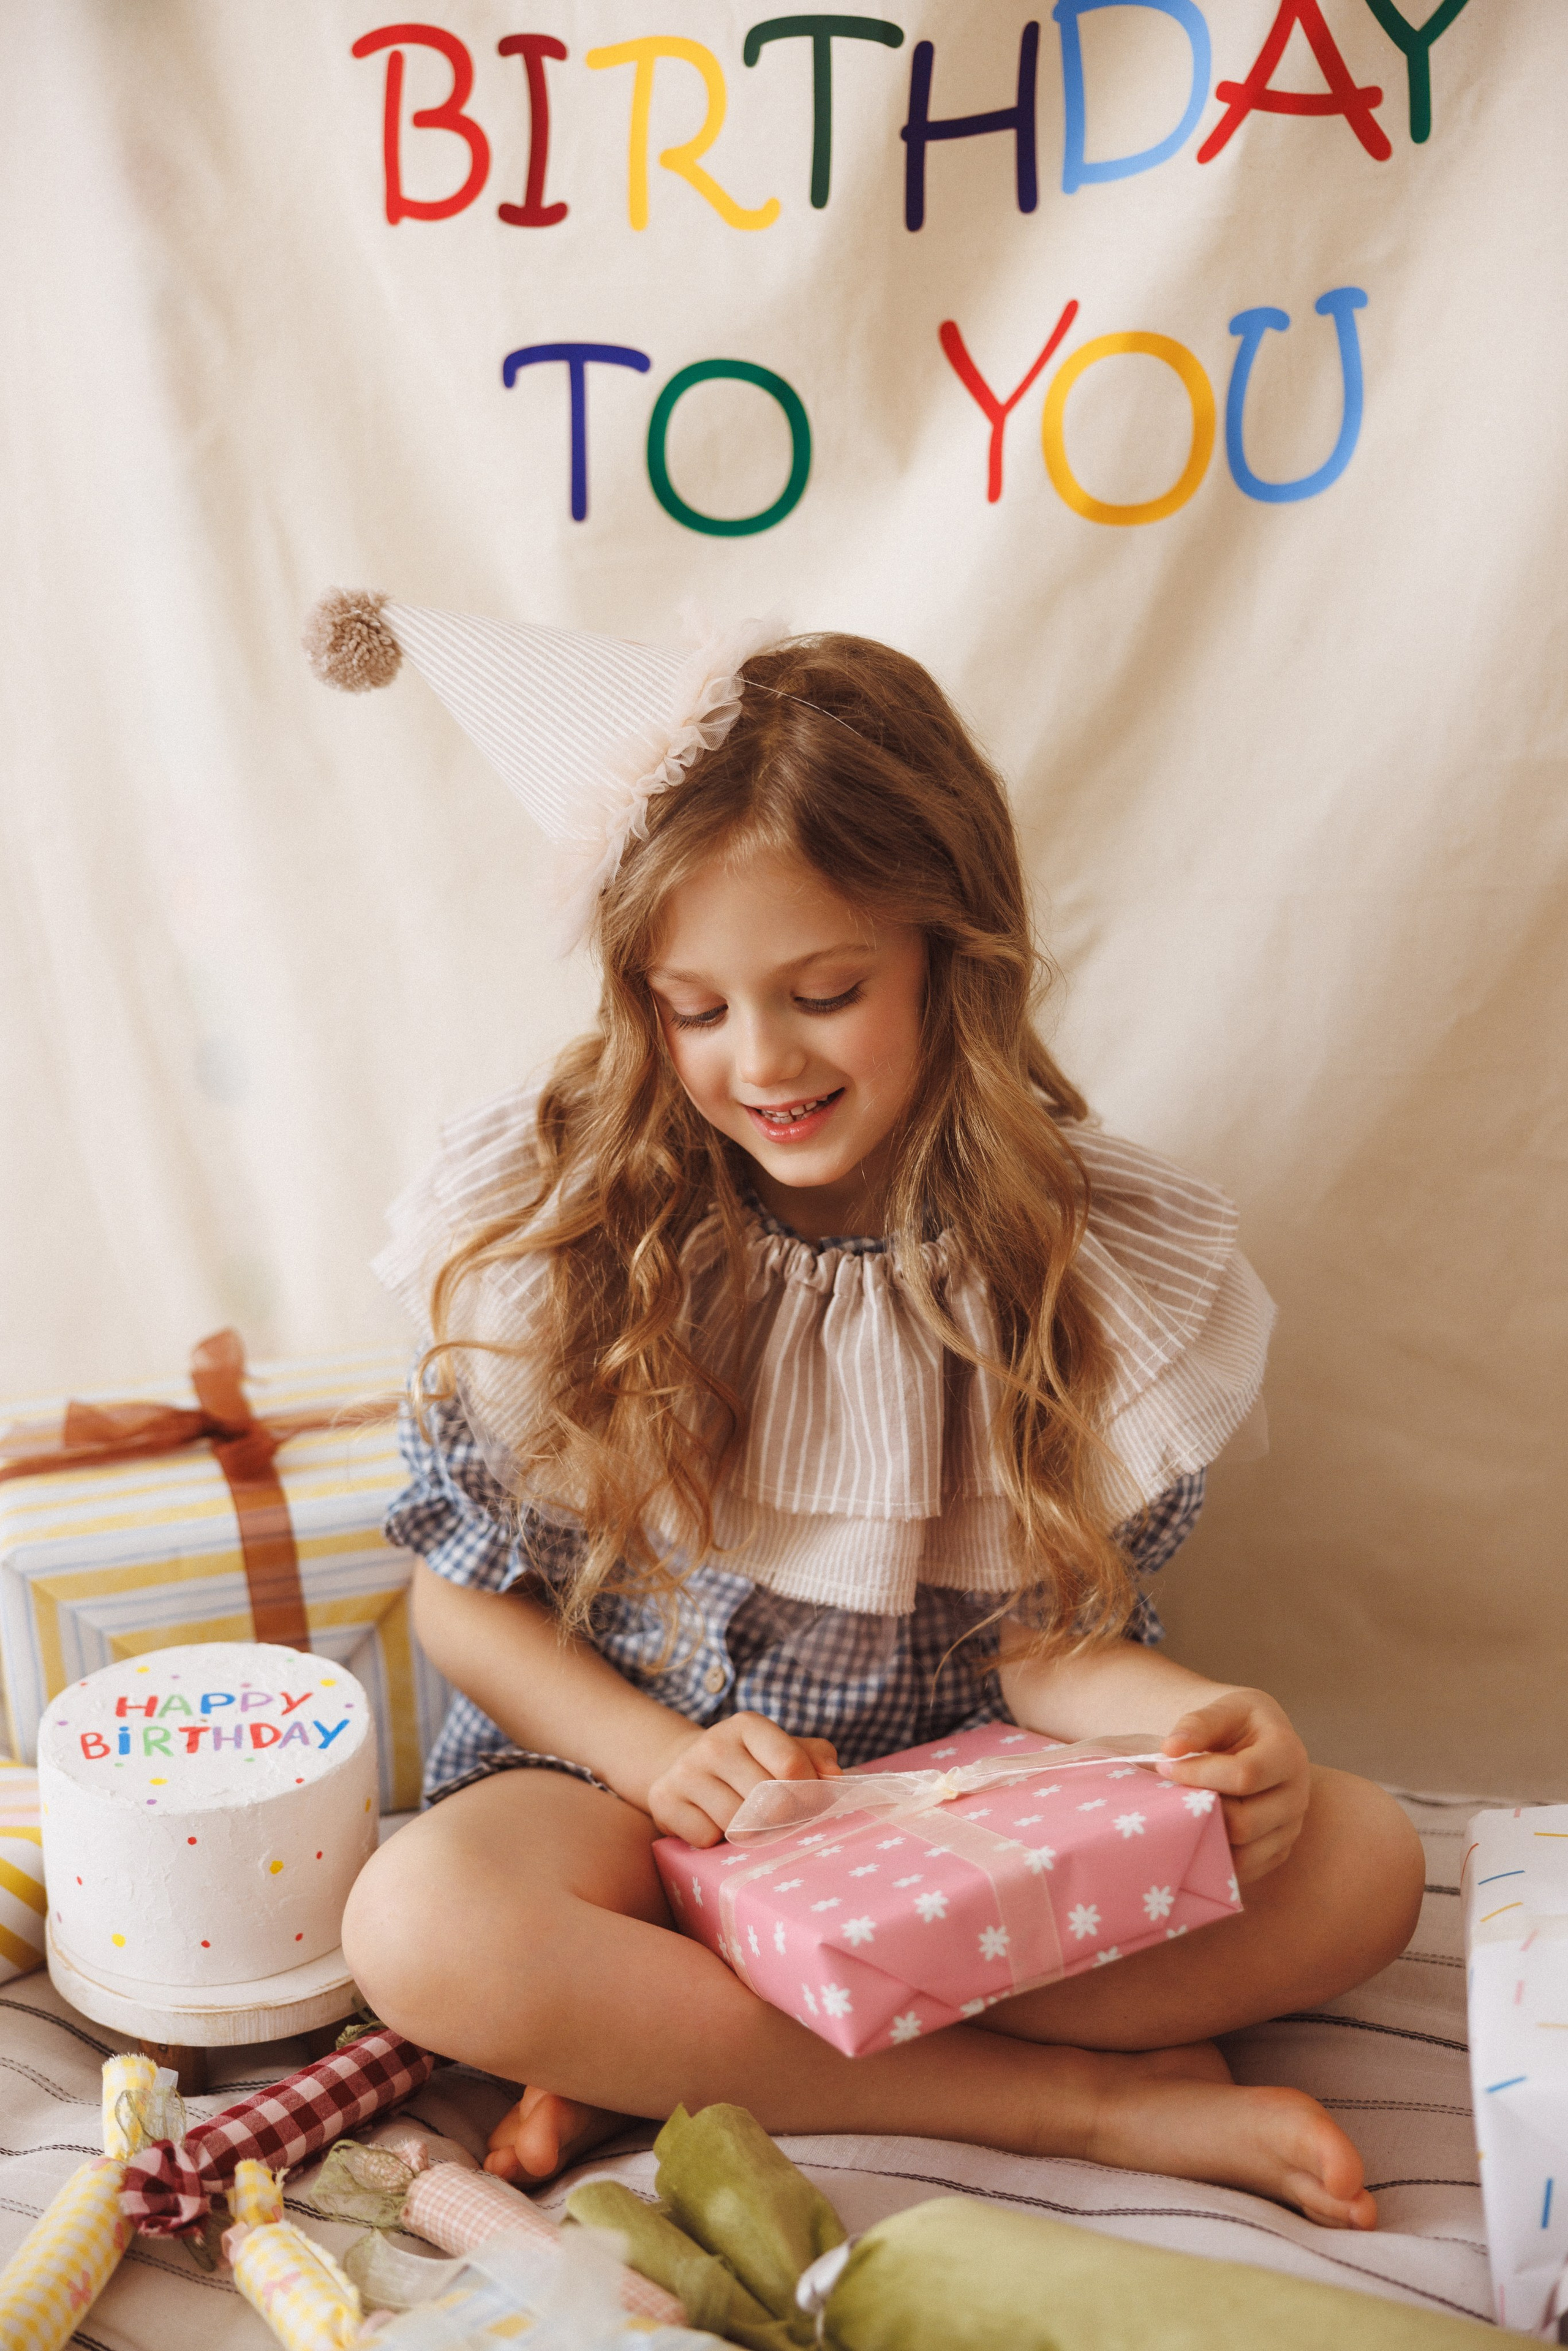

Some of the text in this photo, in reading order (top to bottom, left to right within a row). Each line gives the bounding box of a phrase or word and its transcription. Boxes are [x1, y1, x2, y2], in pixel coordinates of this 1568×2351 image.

[350, 0, 1470, 232] BIRTHDAY
[502, 287, 1369, 538] TO YOU
[115, 1691, 313, 1718] HAPPY
